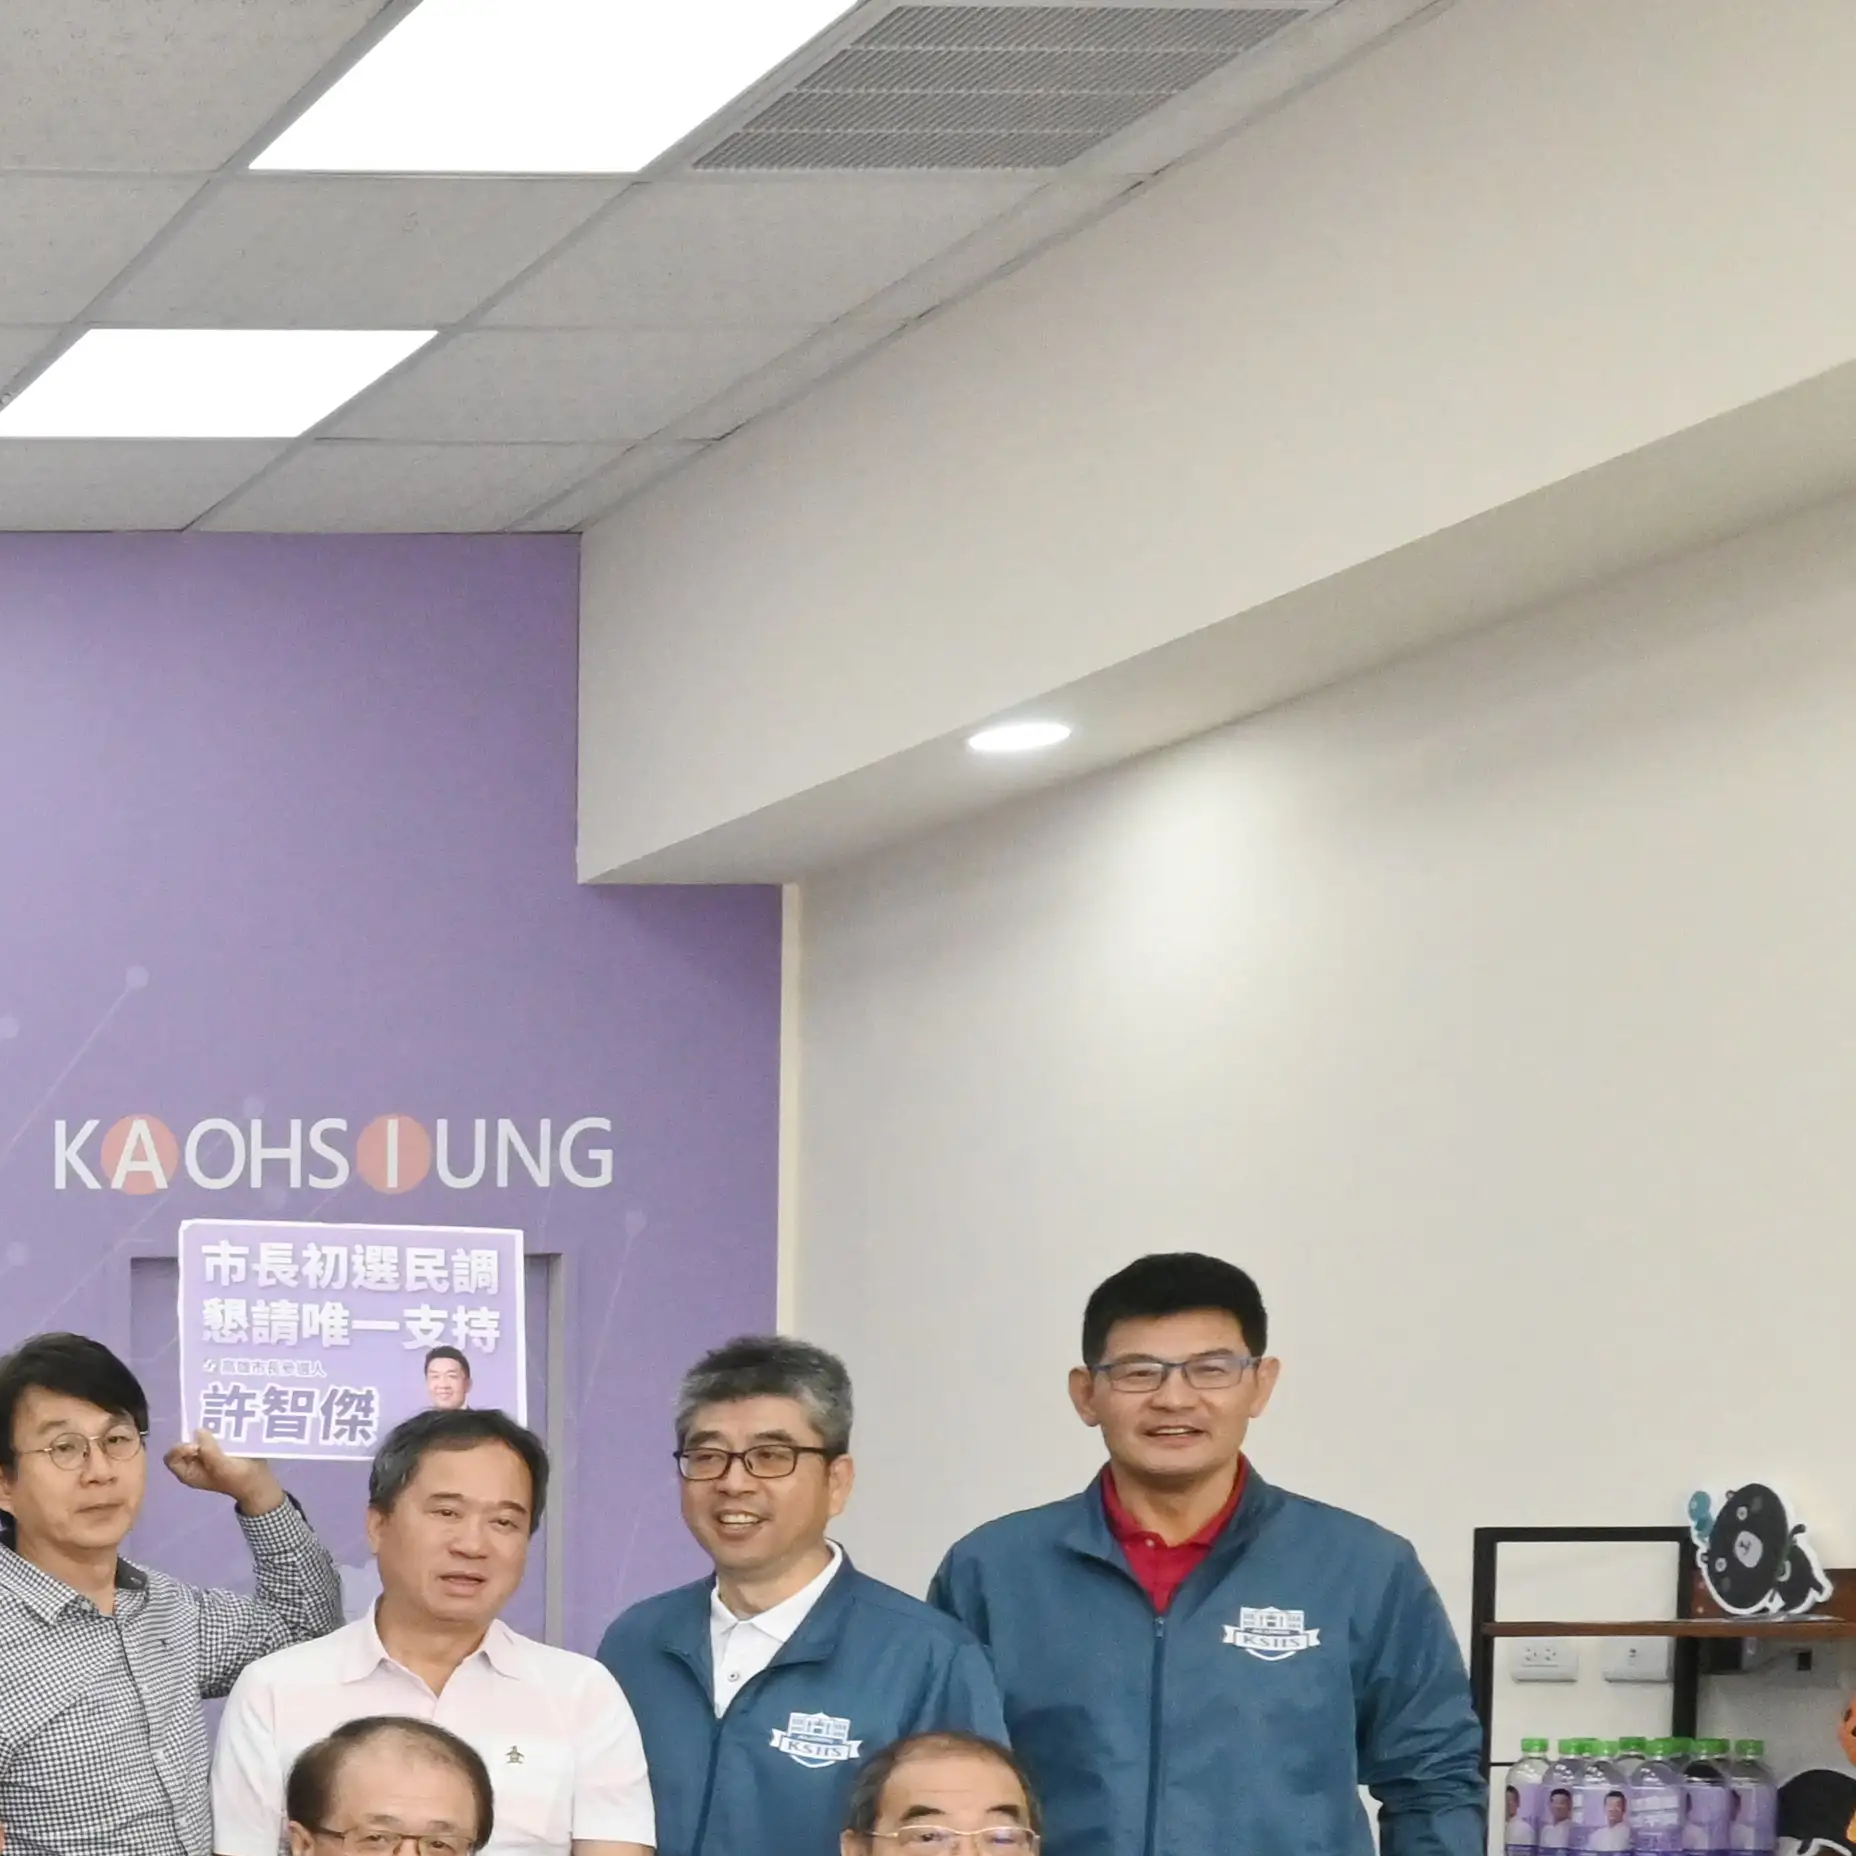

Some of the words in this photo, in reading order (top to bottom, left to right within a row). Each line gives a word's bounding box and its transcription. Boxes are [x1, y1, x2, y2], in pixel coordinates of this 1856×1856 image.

[53, 1116, 614, 1191] KAOHSIUNG
[201, 1239, 500, 1295] 市長初選民調
[201, 1298, 501, 1354] 懇請唯一支持
[200, 1383, 379, 1447] 許智傑
